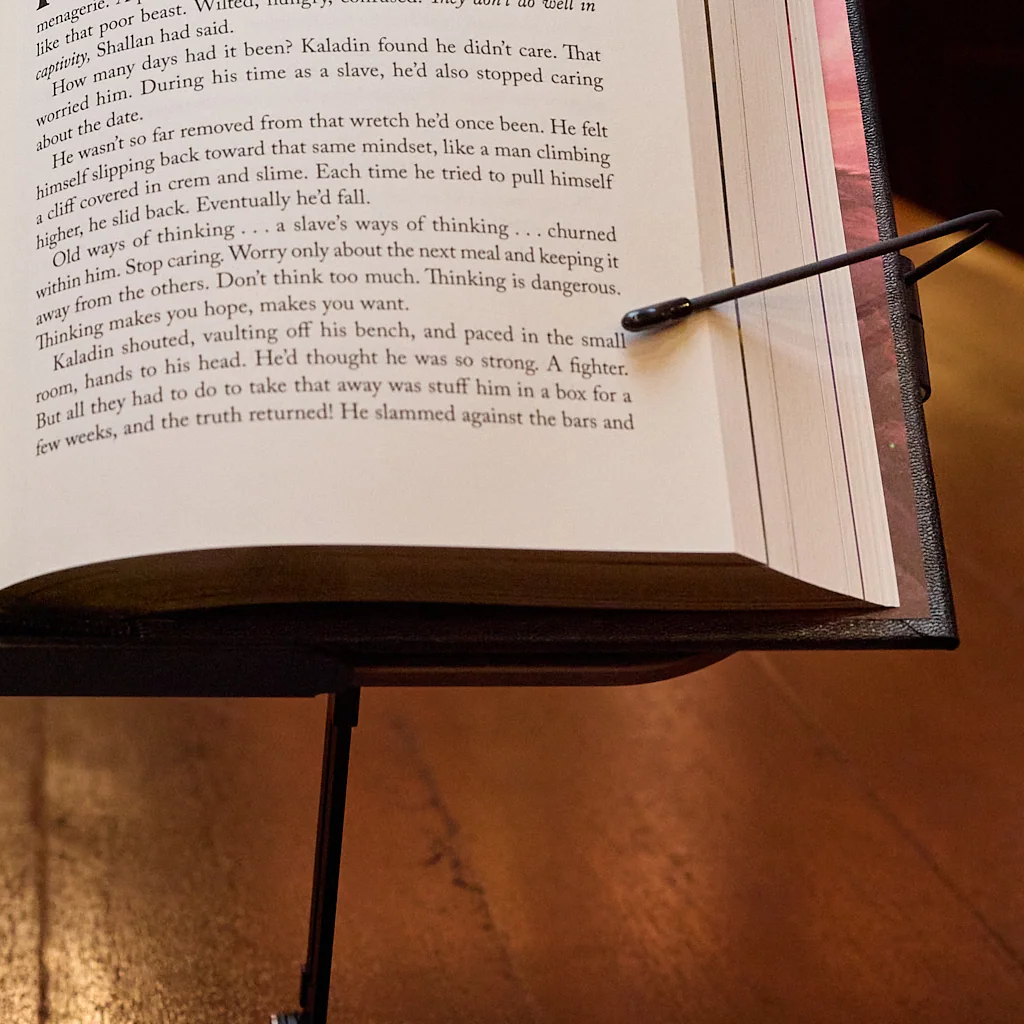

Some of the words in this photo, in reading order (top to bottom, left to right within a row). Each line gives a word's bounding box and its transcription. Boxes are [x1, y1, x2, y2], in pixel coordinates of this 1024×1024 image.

[36, 38, 60, 57] like
[65, 26, 94, 45] that
[99, 15, 135, 39] poor
[140, 4, 187, 23] beast.
[52, 150, 74, 170] He
[77, 135, 125, 160] wasn’t
[129, 135, 147, 148] so
[152, 126, 175, 143] far
[180, 115, 254, 138] removed
[260, 114, 303, 130] from
[309, 112, 344, 128] that
[349, 111, 410, 128] wretch
[415, 112, 450, 129] he’d
[455, 119, 495, 131] once
[499, 115, 545, 134] been.
[550, 118, 577, 136] He
[581, 120, 608, 138] felt
[53, 344, 114, 372] Kaladin
[121, 328, 195, 355] shouted,
[203, 324, 279, 344] vaulting
[286, 320, 313, 338] off
[320, 321, 347, 337] his
[354, 320, 416, 340] bench,
[423, 322, 456, 339] and
[464, 325, 514, 346] paced
[521, 327, 539, 344] in
[546, 328, 574, 346] the
[581, 331, 628, 349] small
[36, 438, 61, 456] few
[65, 423, 118, 447] weeks,
[123, 414, 155, 435] and
[161, 411, 189, 429] the
[195, 405, 242, 426] truth
[249, 402, 333, 422] returned!
[341, 402, 369, 420] He
[375, 403, 456, 422] slammed
[462, 407, 523, 427] against
[529, 408, 556, 427] the
[561, 410, 597, 428] bars
[603, 413, 635, 430] and
